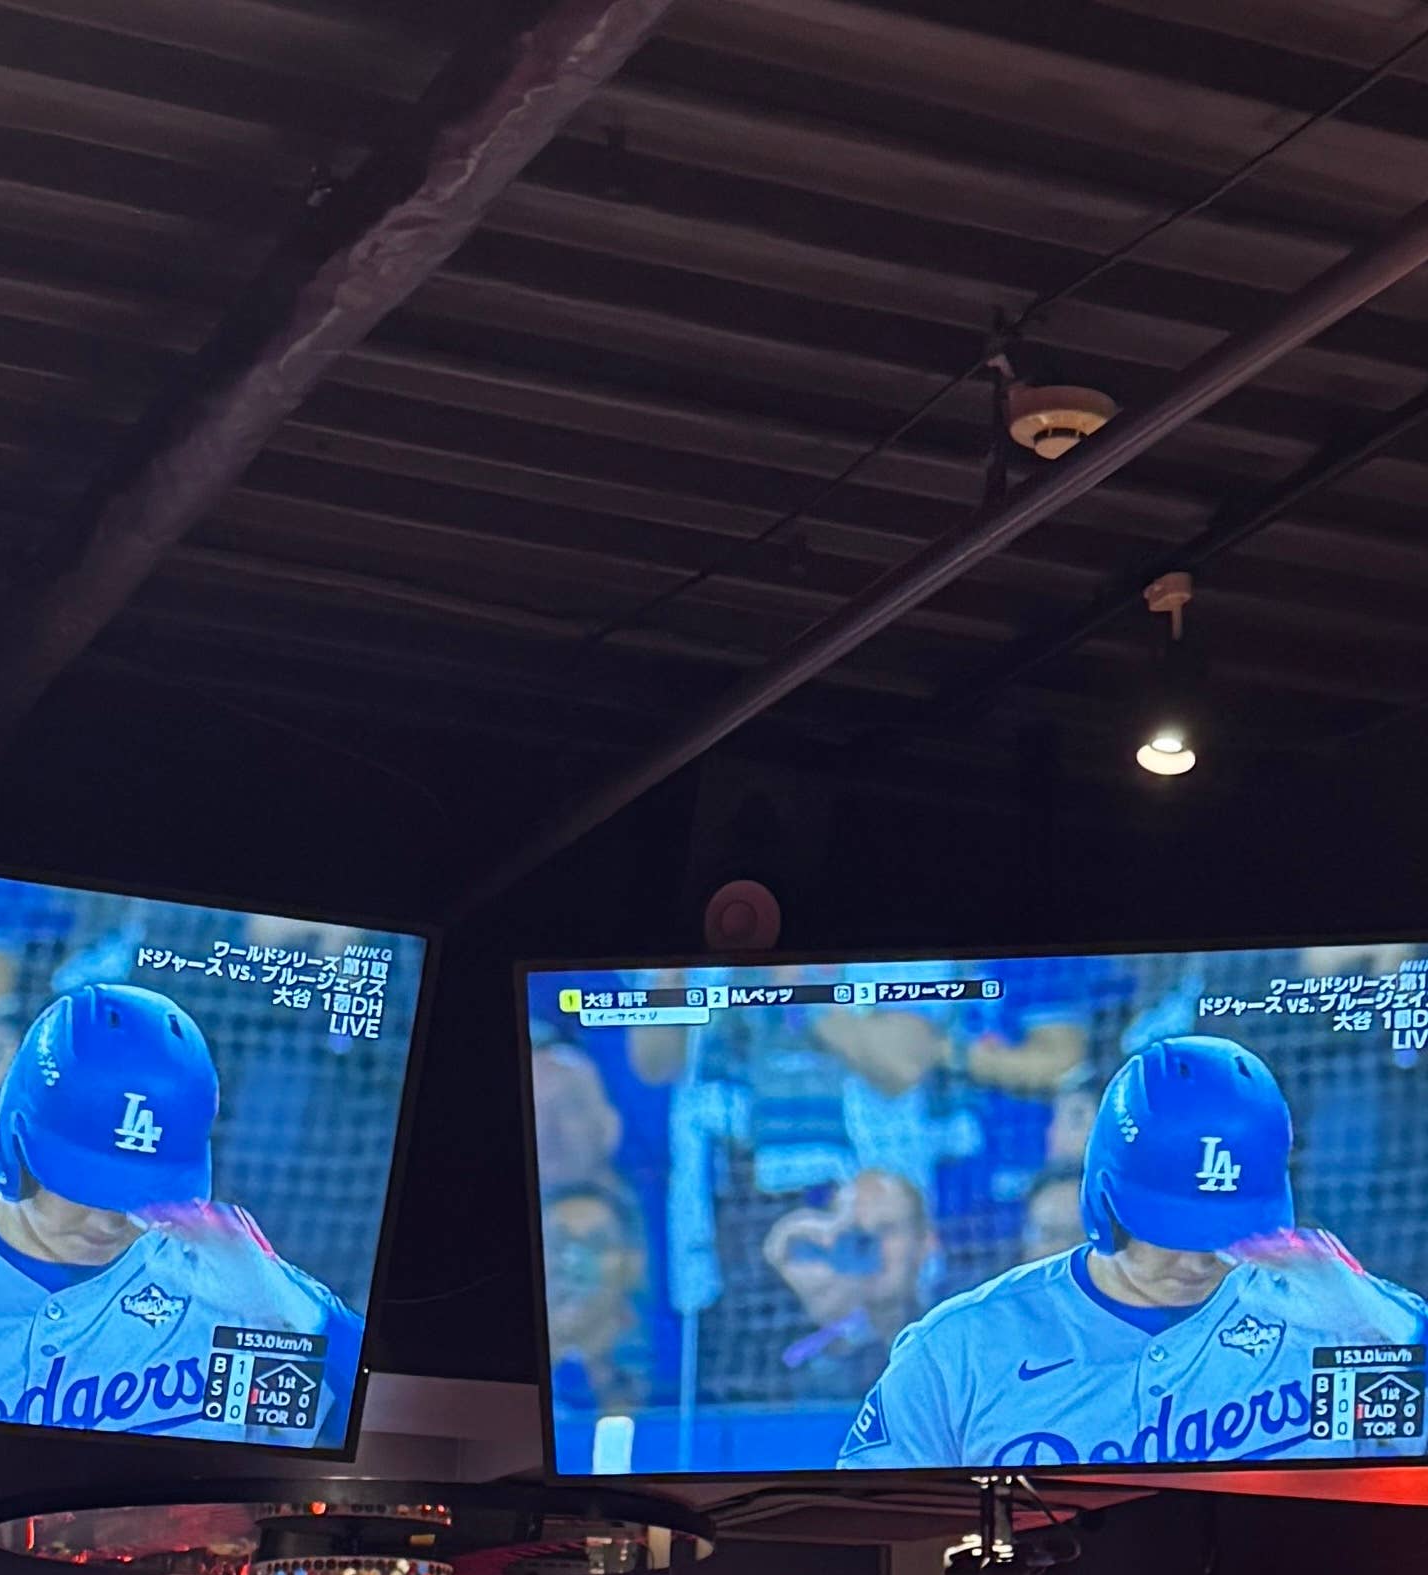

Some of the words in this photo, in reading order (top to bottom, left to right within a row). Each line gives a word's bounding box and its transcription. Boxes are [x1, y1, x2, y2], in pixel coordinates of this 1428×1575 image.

[138, 948, 223, 976] ドジャース
[262, 965, 388, 997] ブルージェイズ
[272, 986, 312, 1009] 大谷
[584, 992, 614, 1008] 大谷
[860, 986, 869, 999] 3
[879, 983, 965, 1000] F.フリーマン
[1199, 996, 1283, 1017] ドジャース
[329, 1013, 381, 1039] LIVE
[1333, 1012, 1372, 1032] 大谷
[114, 1092, 163, 1153] LA
[1195, 1136, 1242, 1192] LA
[214, 1357, 227, 1373] B
[239, 1360, 245, 1375] 1
[210, 1380, 223, 1396] S
[233, 1381, 244, 1397] 0
[1316, 1376, 1329, 1393] B
[1341, 1377, 1348, 1392] 1
[259, 1390, 291, 1406] LAD
[298, 1393, 310, 1408] 0
[1316, 1398, 1328, 1415] S
[1338, 1398, 1349, 1413] 0
[205, 1402, 223, 1418] O
[230, 1404, 241, 1419] 0
[256, 1408, 289, 1425] TOR
[295, 1411, 307, 1426] 0
[1364, 1403, 1397, 1418] LAD
[1403, 1402, 1416, 1418] 0
[1313, 1421, 1330, 1437] O
[1337, 1421, 1348, 1436] 0
[1363, 1421, 1397, 1436] TOR
[1403, 1420, 1416, 1436] 0
